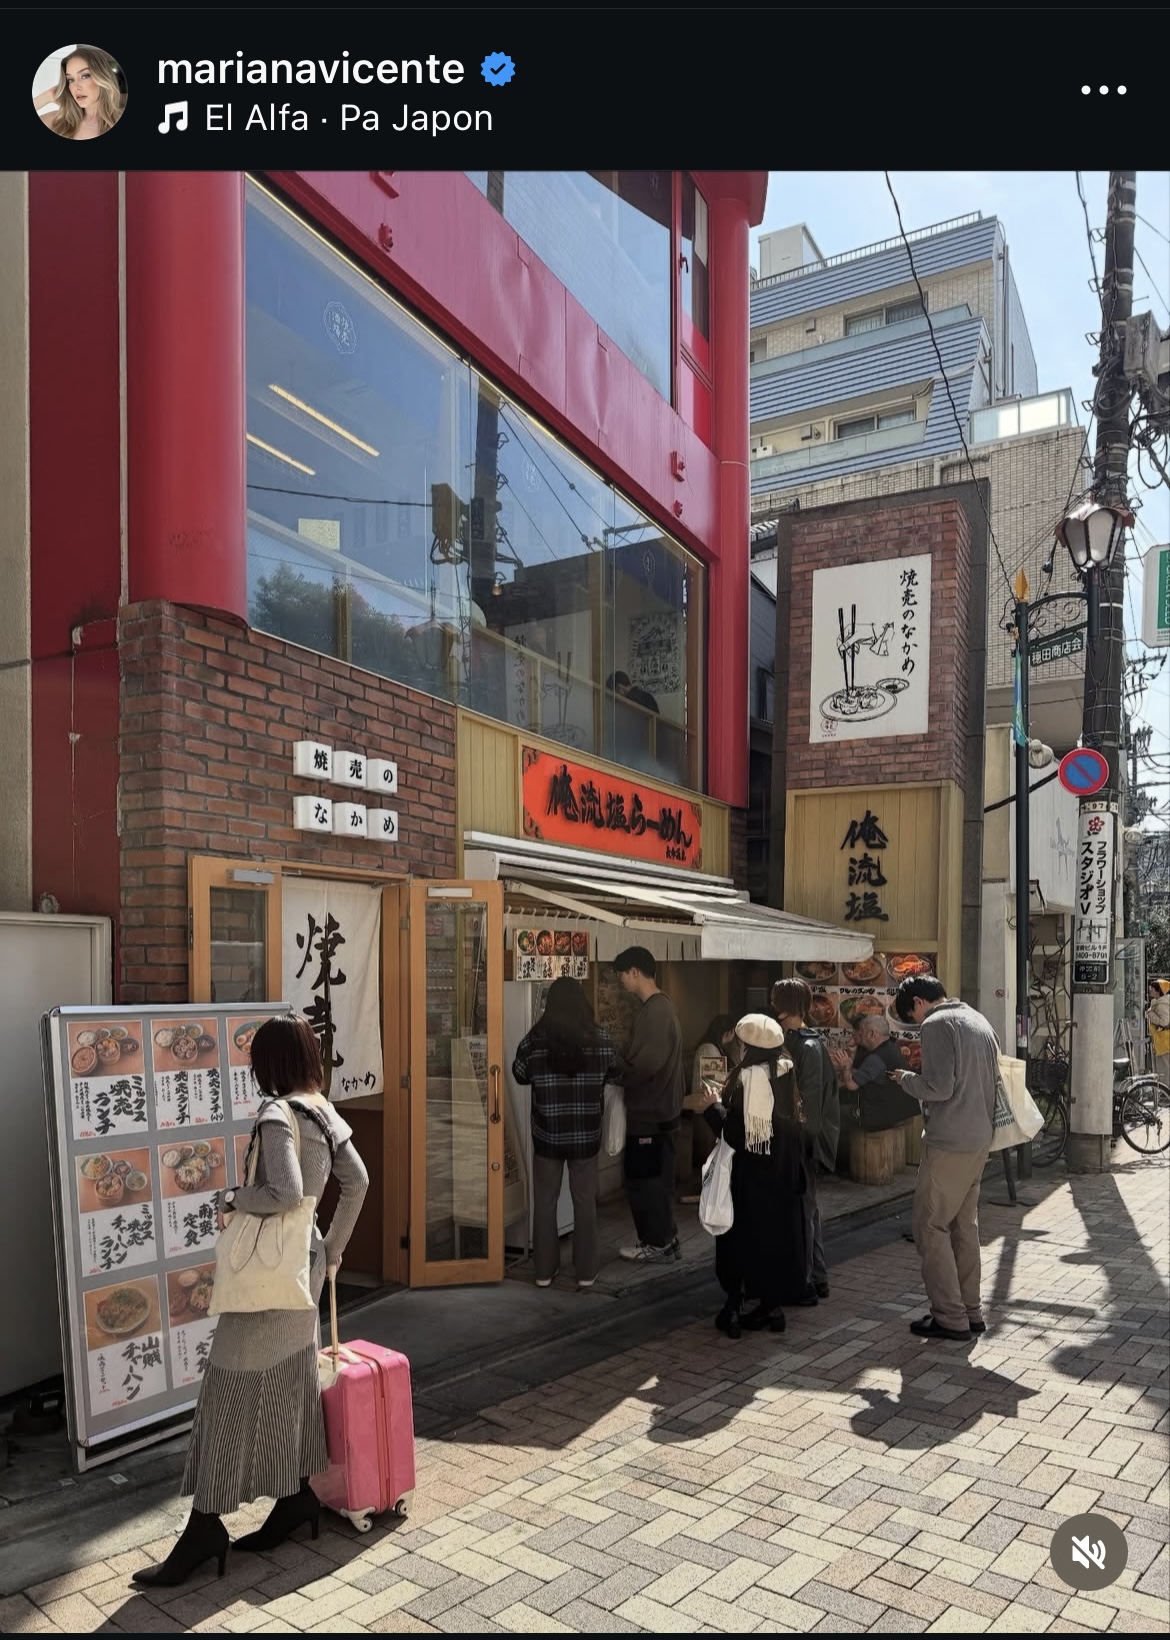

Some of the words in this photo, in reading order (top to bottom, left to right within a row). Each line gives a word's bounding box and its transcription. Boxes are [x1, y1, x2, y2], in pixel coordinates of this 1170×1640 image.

[900, 569, 919, 676] 焼売のなかめ
[314, 749, 393, 784] 焼売の
[314, 804, 395, 834] なかめ
[546, 764, 692, 848] 俺流塩らーめん
[840, 810, 889, 922] 俺流塩
[1080, 841, 1094, 915] スタジオV
[1096, 841, 1107, 914] フラワーショップ
[296, 912, 347, 1068] 焼売
[109, 1080, 134, 1115] 焼売
[132, 1075, 147, 1122] ミックス
[174, 1071, 190, 1125] 焼売ランチ
[342, 1071, 376, 1092] なかめ
[93, 1092, 115, 1135] ランチ
[111, 1214, 128, 1264] チャーハン
[127, 1219, 144, 1246] 焼売
[141, 1203, 155, 1241] ミックス
[183, 1213, 200, 1247] 定食
[199, 1202, 215, 1238] 南蛮
[100, 1235, 116, 1270] ランチ
[121, 1342, 143, 1400] チャーハン
[141, 1336, 162, 1369] 山賊
